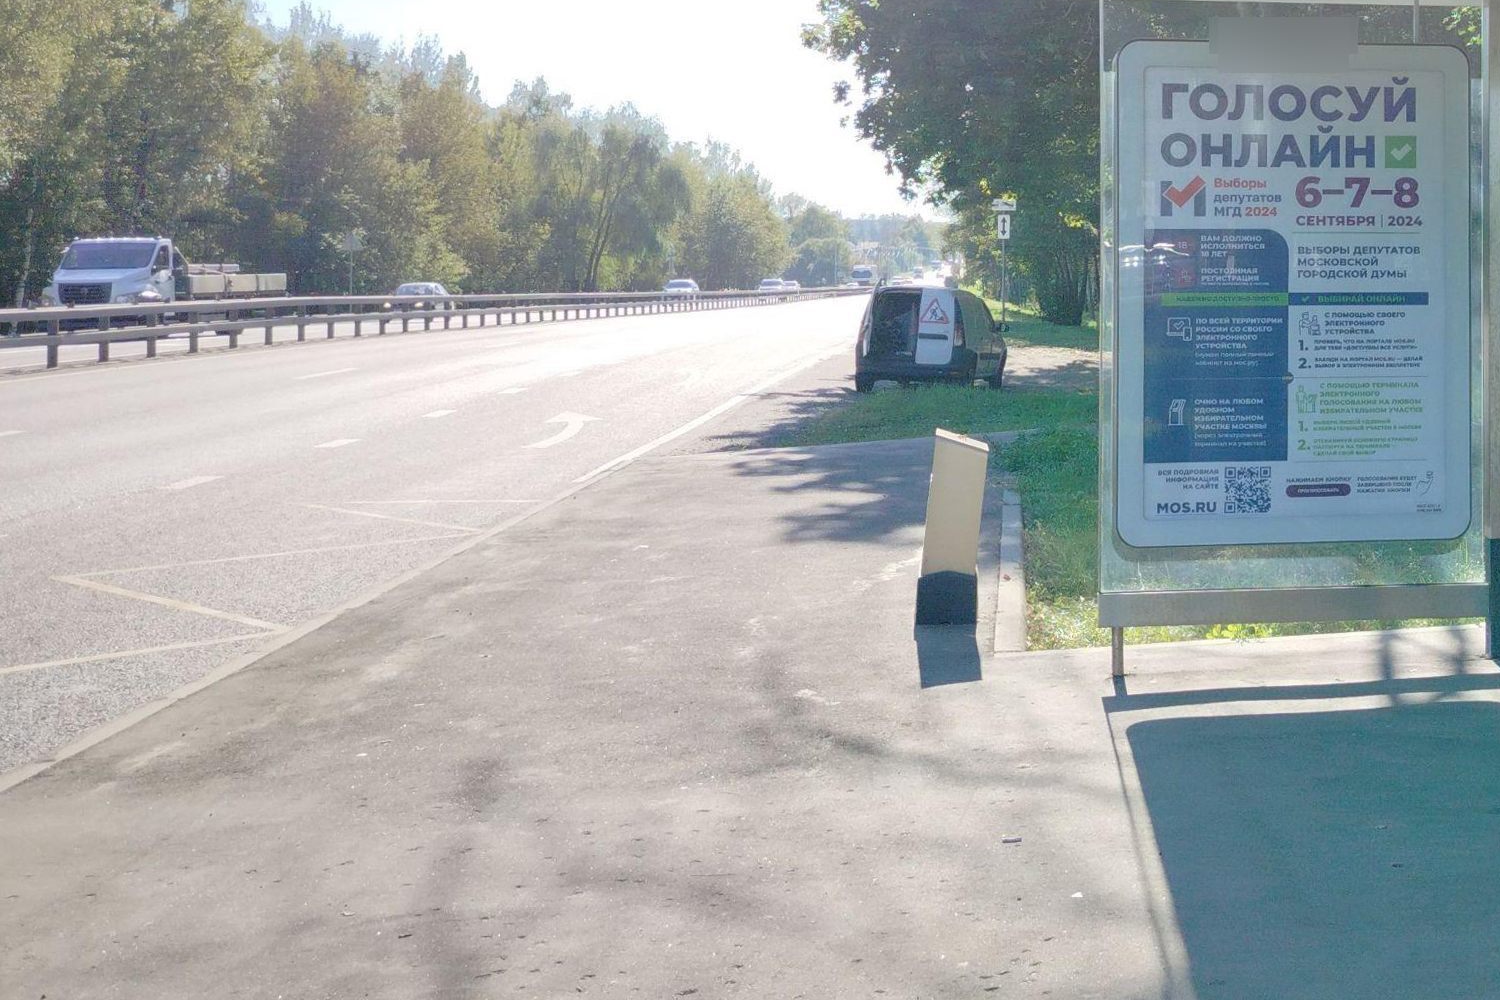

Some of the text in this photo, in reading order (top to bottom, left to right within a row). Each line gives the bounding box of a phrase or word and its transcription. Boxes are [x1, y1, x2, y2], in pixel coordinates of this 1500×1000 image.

[1161, 76, 1416, 122] ГОЛОСУЙ
[1160, 125, 1376, 168] ОНЛАЙН
[1213, 177, 1267, 189] Выборы
[1213, 193, 1282, 204] депутатов
[1213, 206, 1278, 218] МГД 2024
[1296, 215, 1422, 227] СЕНТЯБРЯ 2024
[1297, 246, 1420, 256] ВЫБОРЫ ДЕПУТАТОВ
[1297, 256, 1379, 266] МОСКОВСКОЙ
[1298, 268, 1407, 279] ГОРОДСКОЙ ДУМЫ
[1324, 327, 1375, 335] УСТРОЙСТВА
[1157, 501, 1217, 514] MOS.RU
